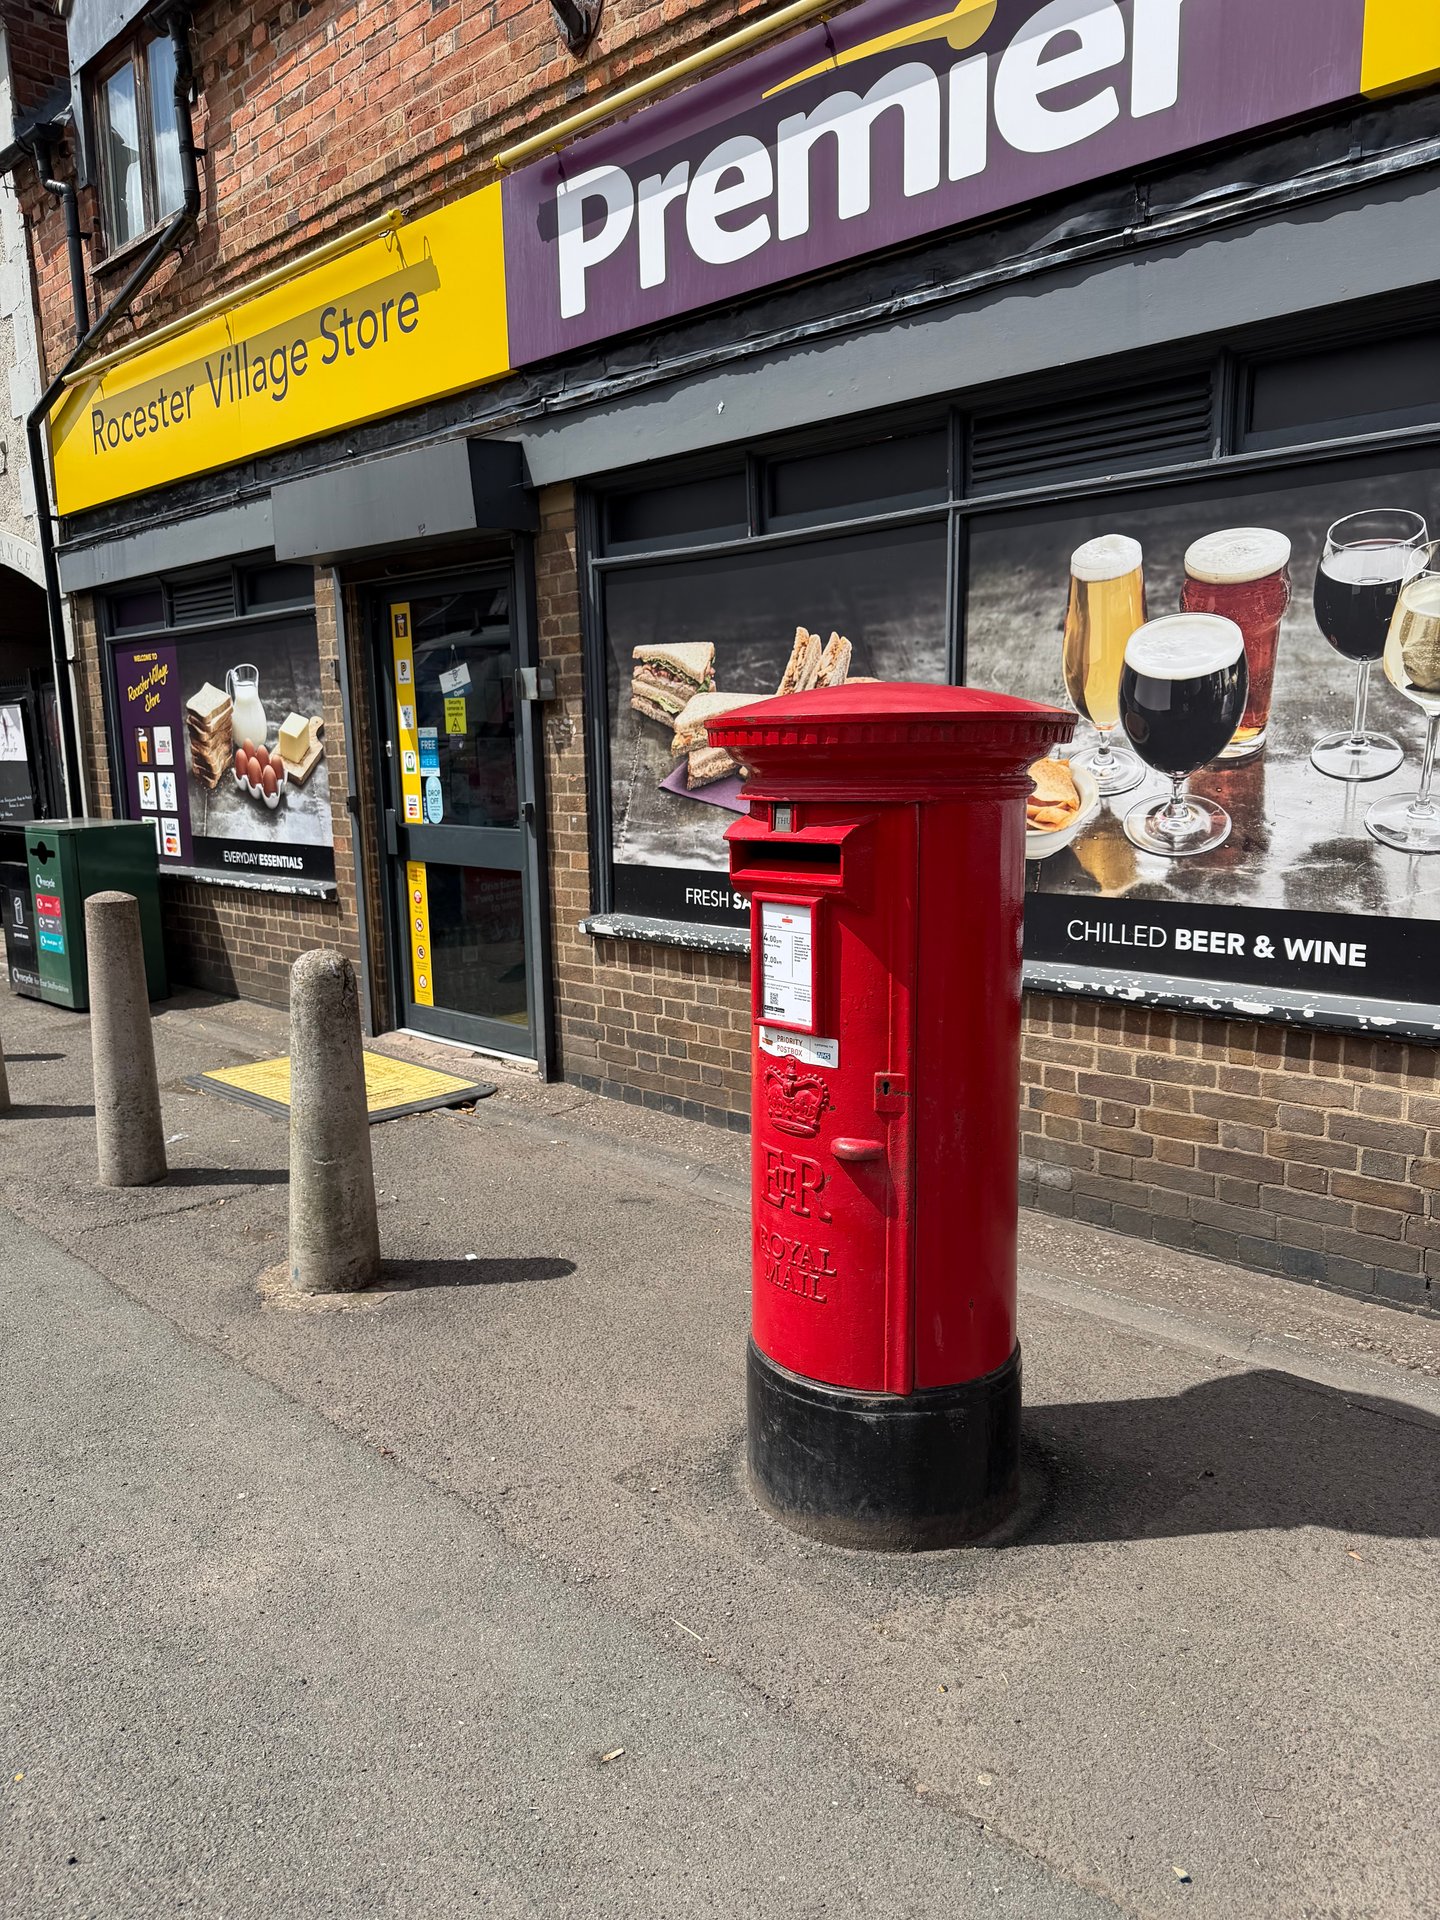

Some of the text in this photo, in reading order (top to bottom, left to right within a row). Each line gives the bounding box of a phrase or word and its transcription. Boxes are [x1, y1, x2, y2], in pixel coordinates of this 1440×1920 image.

[91, 291, 420, 455] Rocester Village Store
[133, 652, 158, 662] WELCOME TO
[127, 663, 169, 702] Rocester Village
[453, 688, 465, 697] Open
[144, 692, 161, 712] Store
[420, 740, 436, 749] FREE
[422, 758, 437, 766] HERE
[428, 789, 441, 797] DROP
[165, 820, 176, 831] VISA
[777, 817, 790, 825] THU
[223, 850, 304, 870] EVERYDAY ESSENTIALS
[685, 887, 752, 910] FRESH SA
[1066, 919, 1367, 968] CHILLED BEER & WINE
[776, 1034, 804, 1047] PRIORITY
[776, 1045, 803, 1057] POSTBOX
[817, 1052, 831, 1060] NHS
[760, 1223, 838, 1278] ROYAL
[765, 1254, 829, 1304] MAIL
